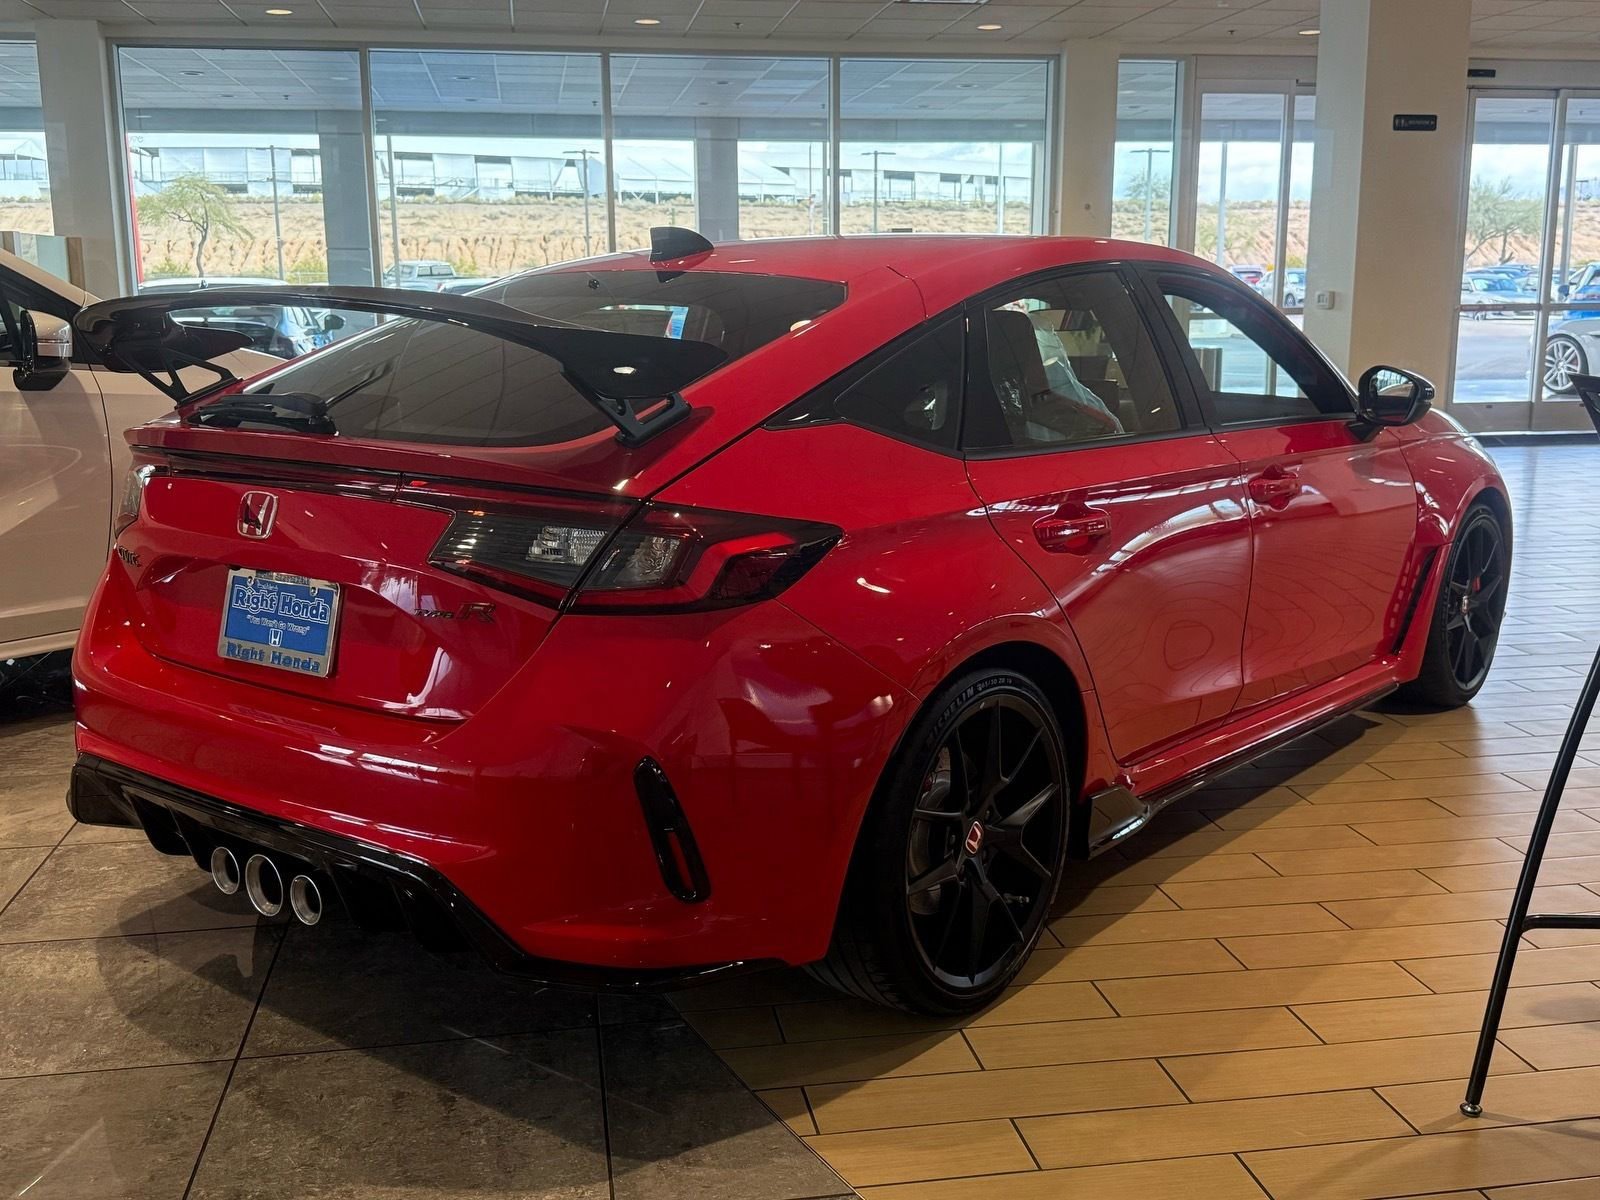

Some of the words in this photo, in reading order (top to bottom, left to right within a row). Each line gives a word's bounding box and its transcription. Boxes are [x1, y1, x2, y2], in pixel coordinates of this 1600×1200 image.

[232, 585, 278, 614] Right
[279, 592, 330, 624] Honda
[456, 602, 496, 624] R
[226, 641, 265, 661] Right
[270, 651, 320, 673] Honda
[926, 686, 974, 745] MICHELIN
